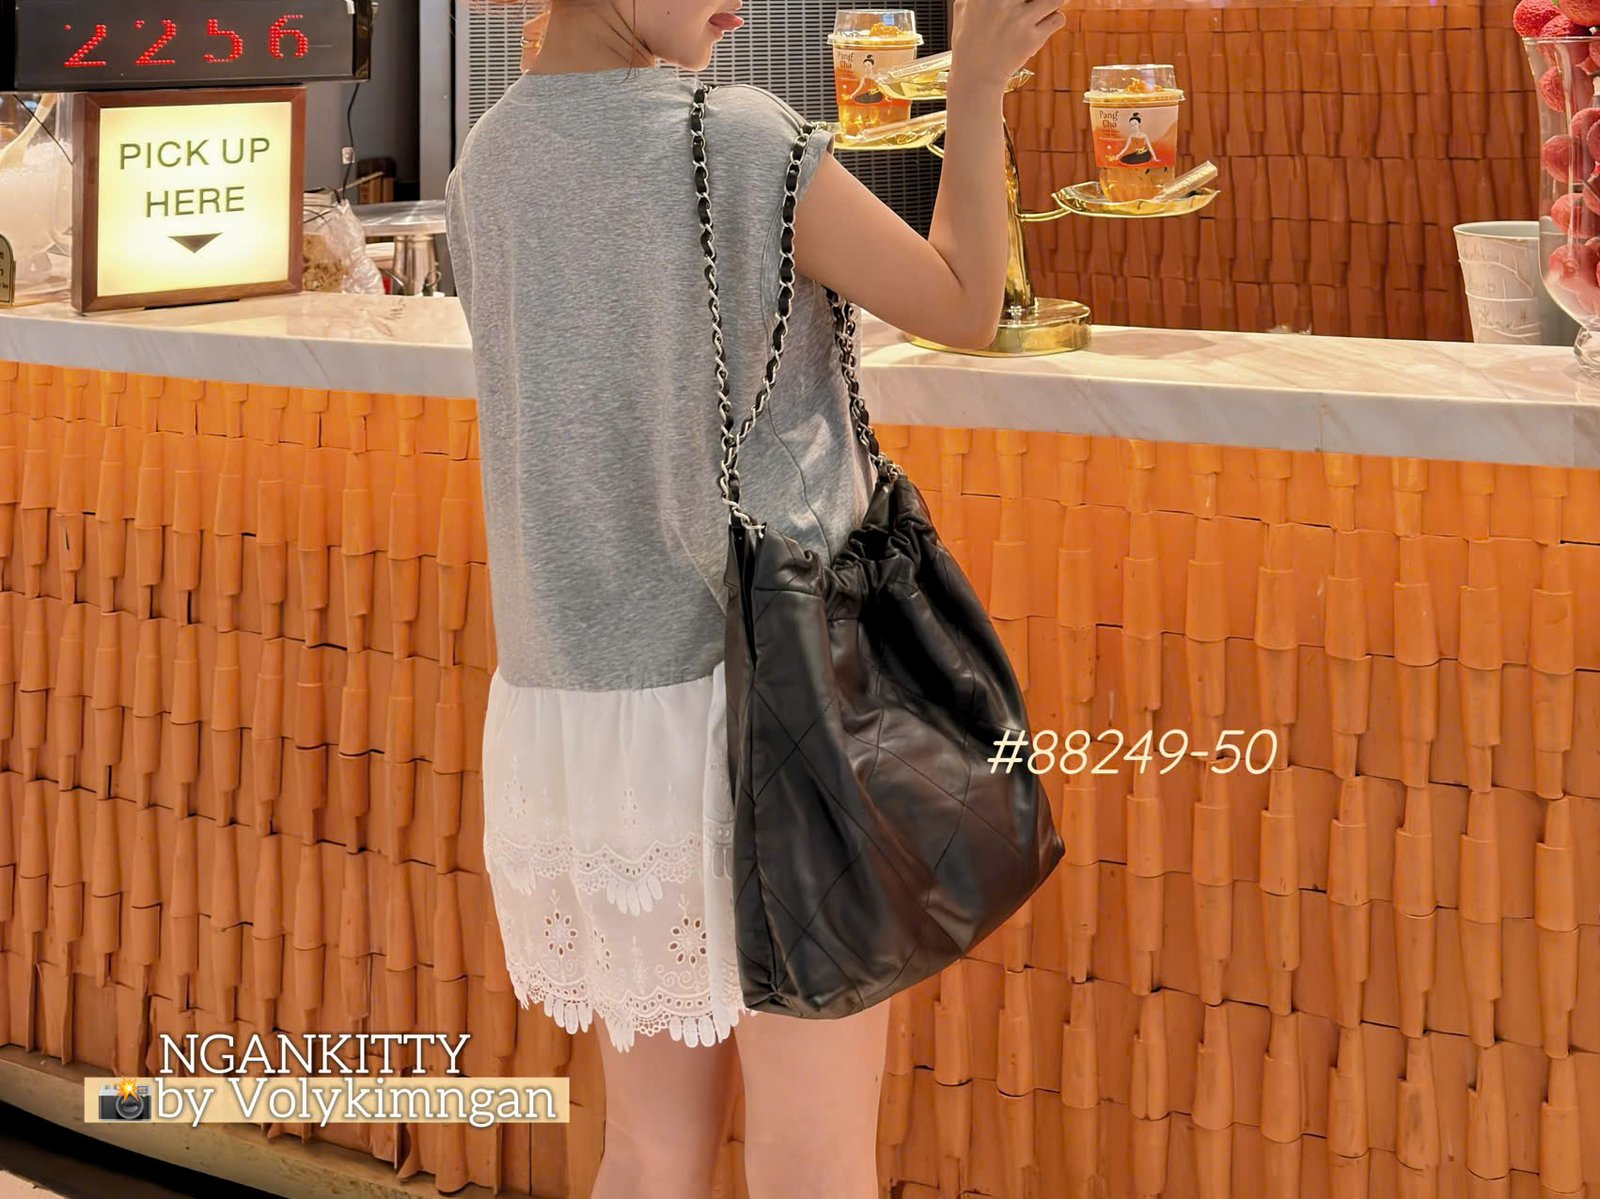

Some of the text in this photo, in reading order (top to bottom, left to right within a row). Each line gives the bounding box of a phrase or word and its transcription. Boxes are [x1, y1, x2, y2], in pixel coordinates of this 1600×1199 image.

[1099, 110, 1119, 121] Pang
[119, 137, 271, 171] PICK UP
[145, 185, 246, 218] HERE
